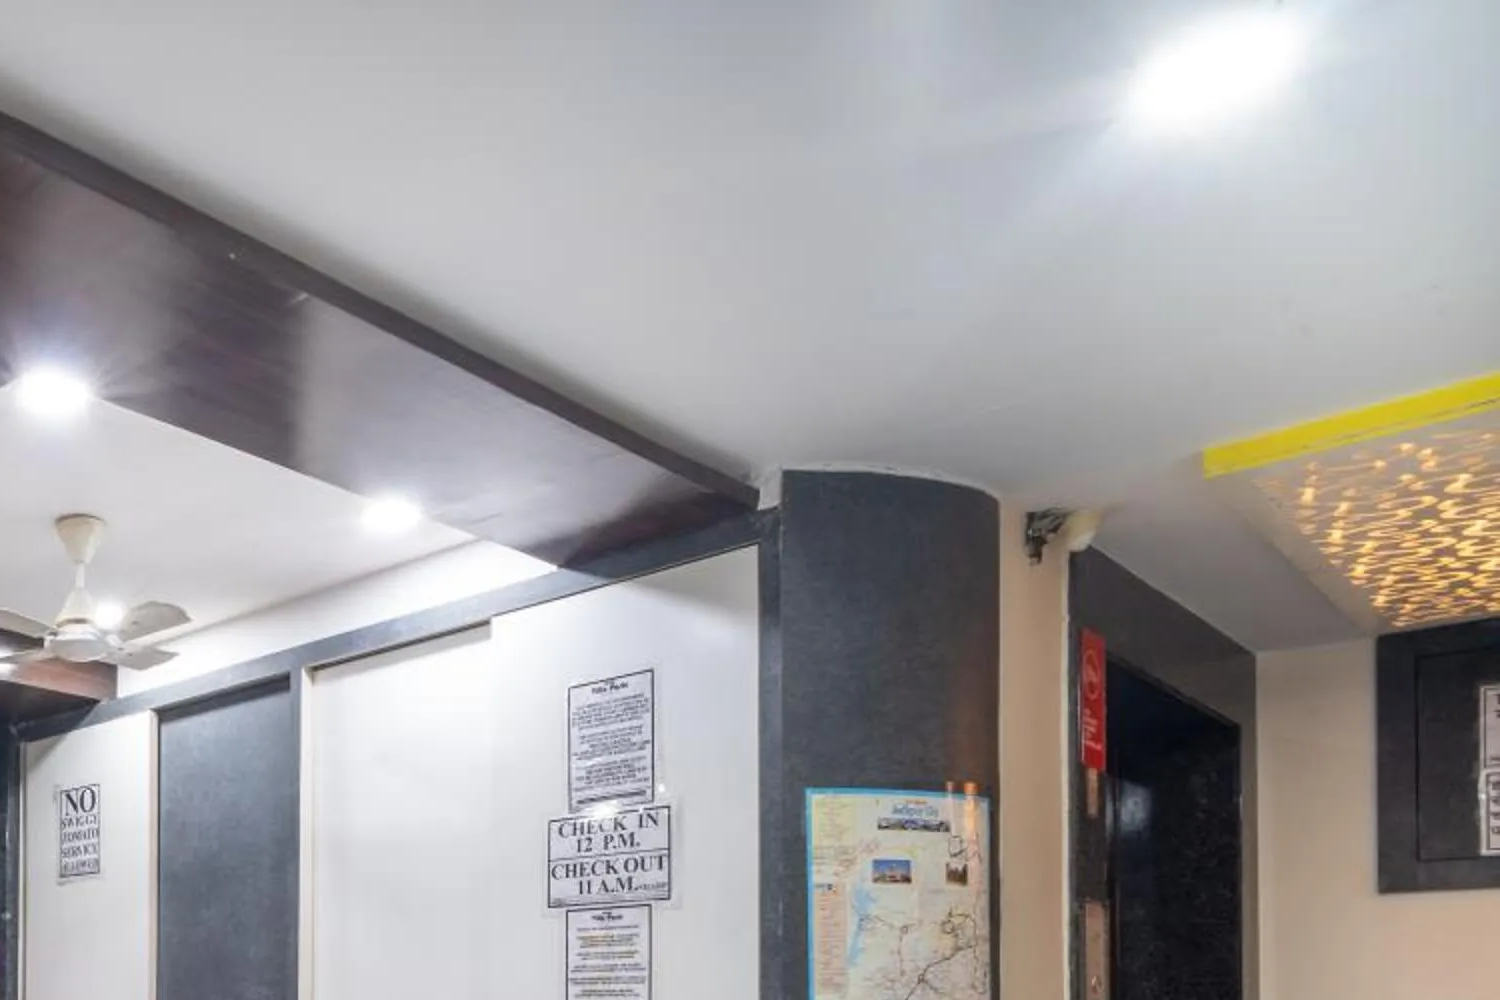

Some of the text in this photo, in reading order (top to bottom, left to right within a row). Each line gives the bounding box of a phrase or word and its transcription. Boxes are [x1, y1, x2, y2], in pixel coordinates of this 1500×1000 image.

[65, 786, 96, 816] NO
[558, 811, 659, 839] CHECK IN
[577, 832, 641, 853] 12 P.M.
[551, 855, 665, 880] CHECK OUT
[579, 880, 592, 895] 11
